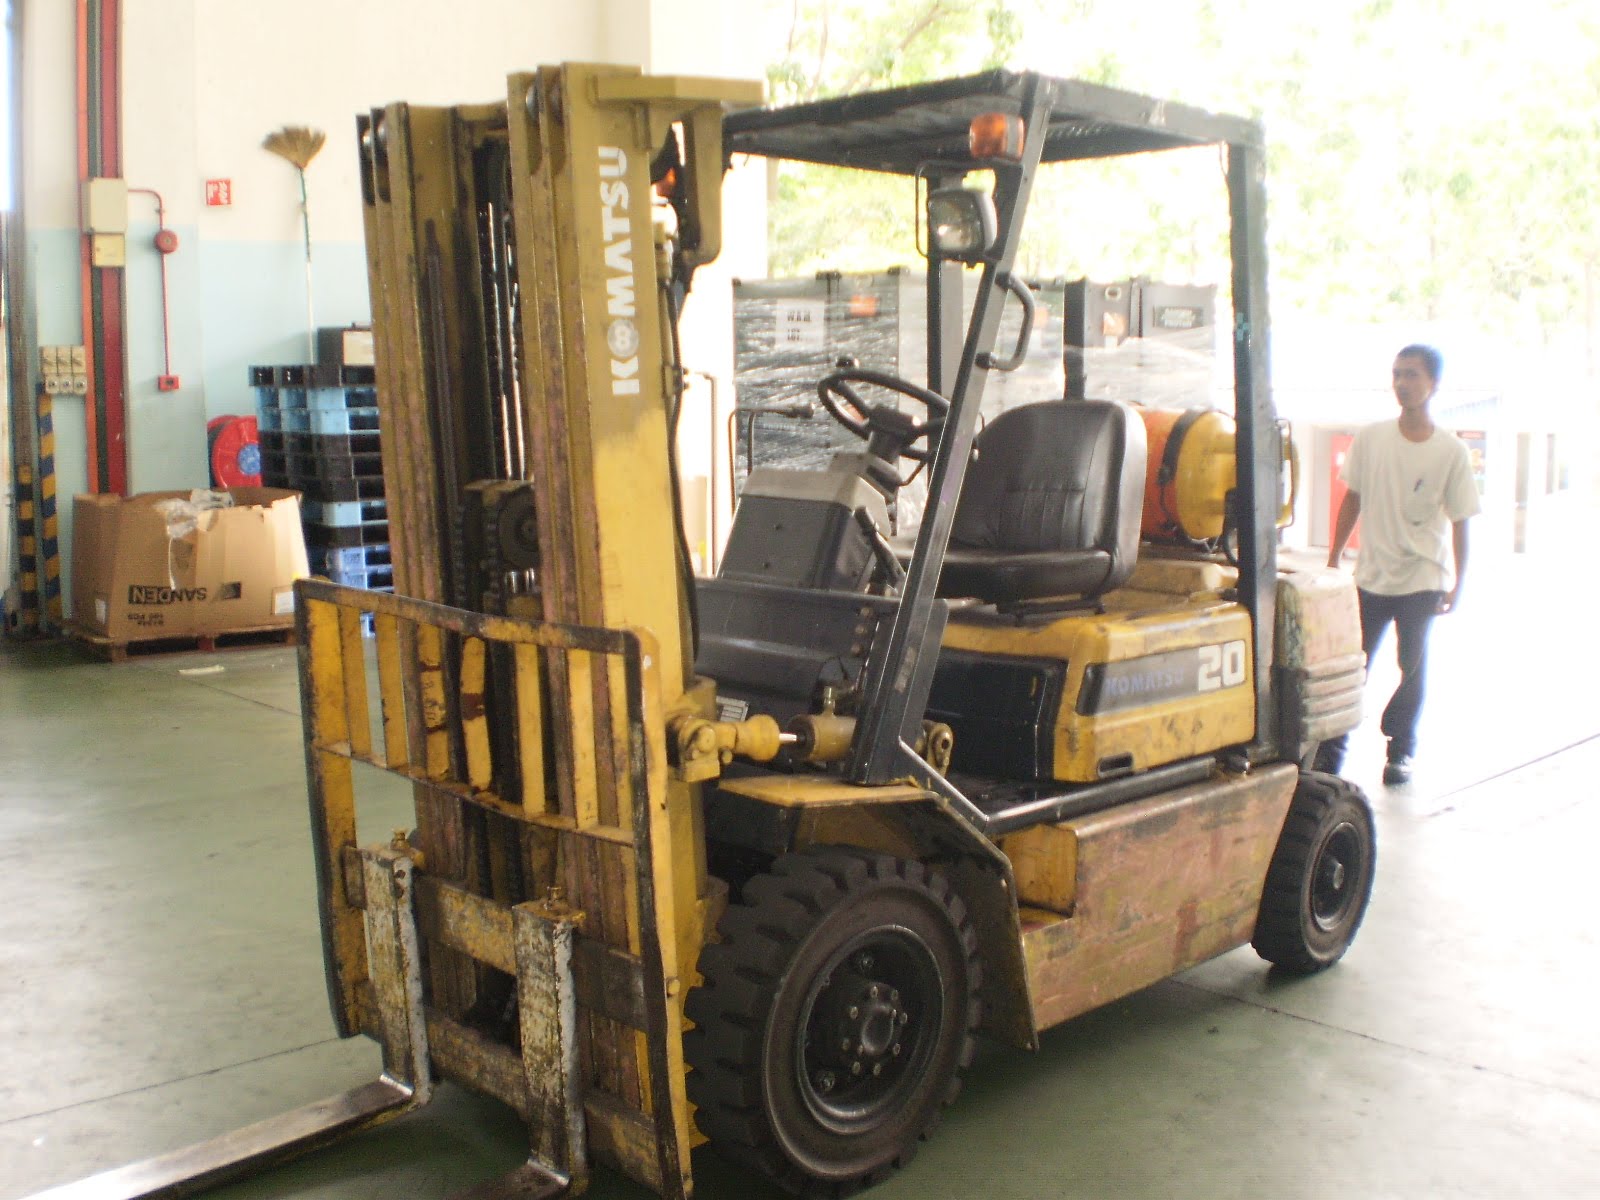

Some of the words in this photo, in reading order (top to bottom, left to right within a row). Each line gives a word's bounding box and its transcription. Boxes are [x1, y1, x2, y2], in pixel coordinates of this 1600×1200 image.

[598, 146, 640, 395] KOMATSU
[129, 584, 208, 604] SANDEN
[1104, 668, 1185, 697] KOMATSU
[1198, 639, 1247, 692] 20
